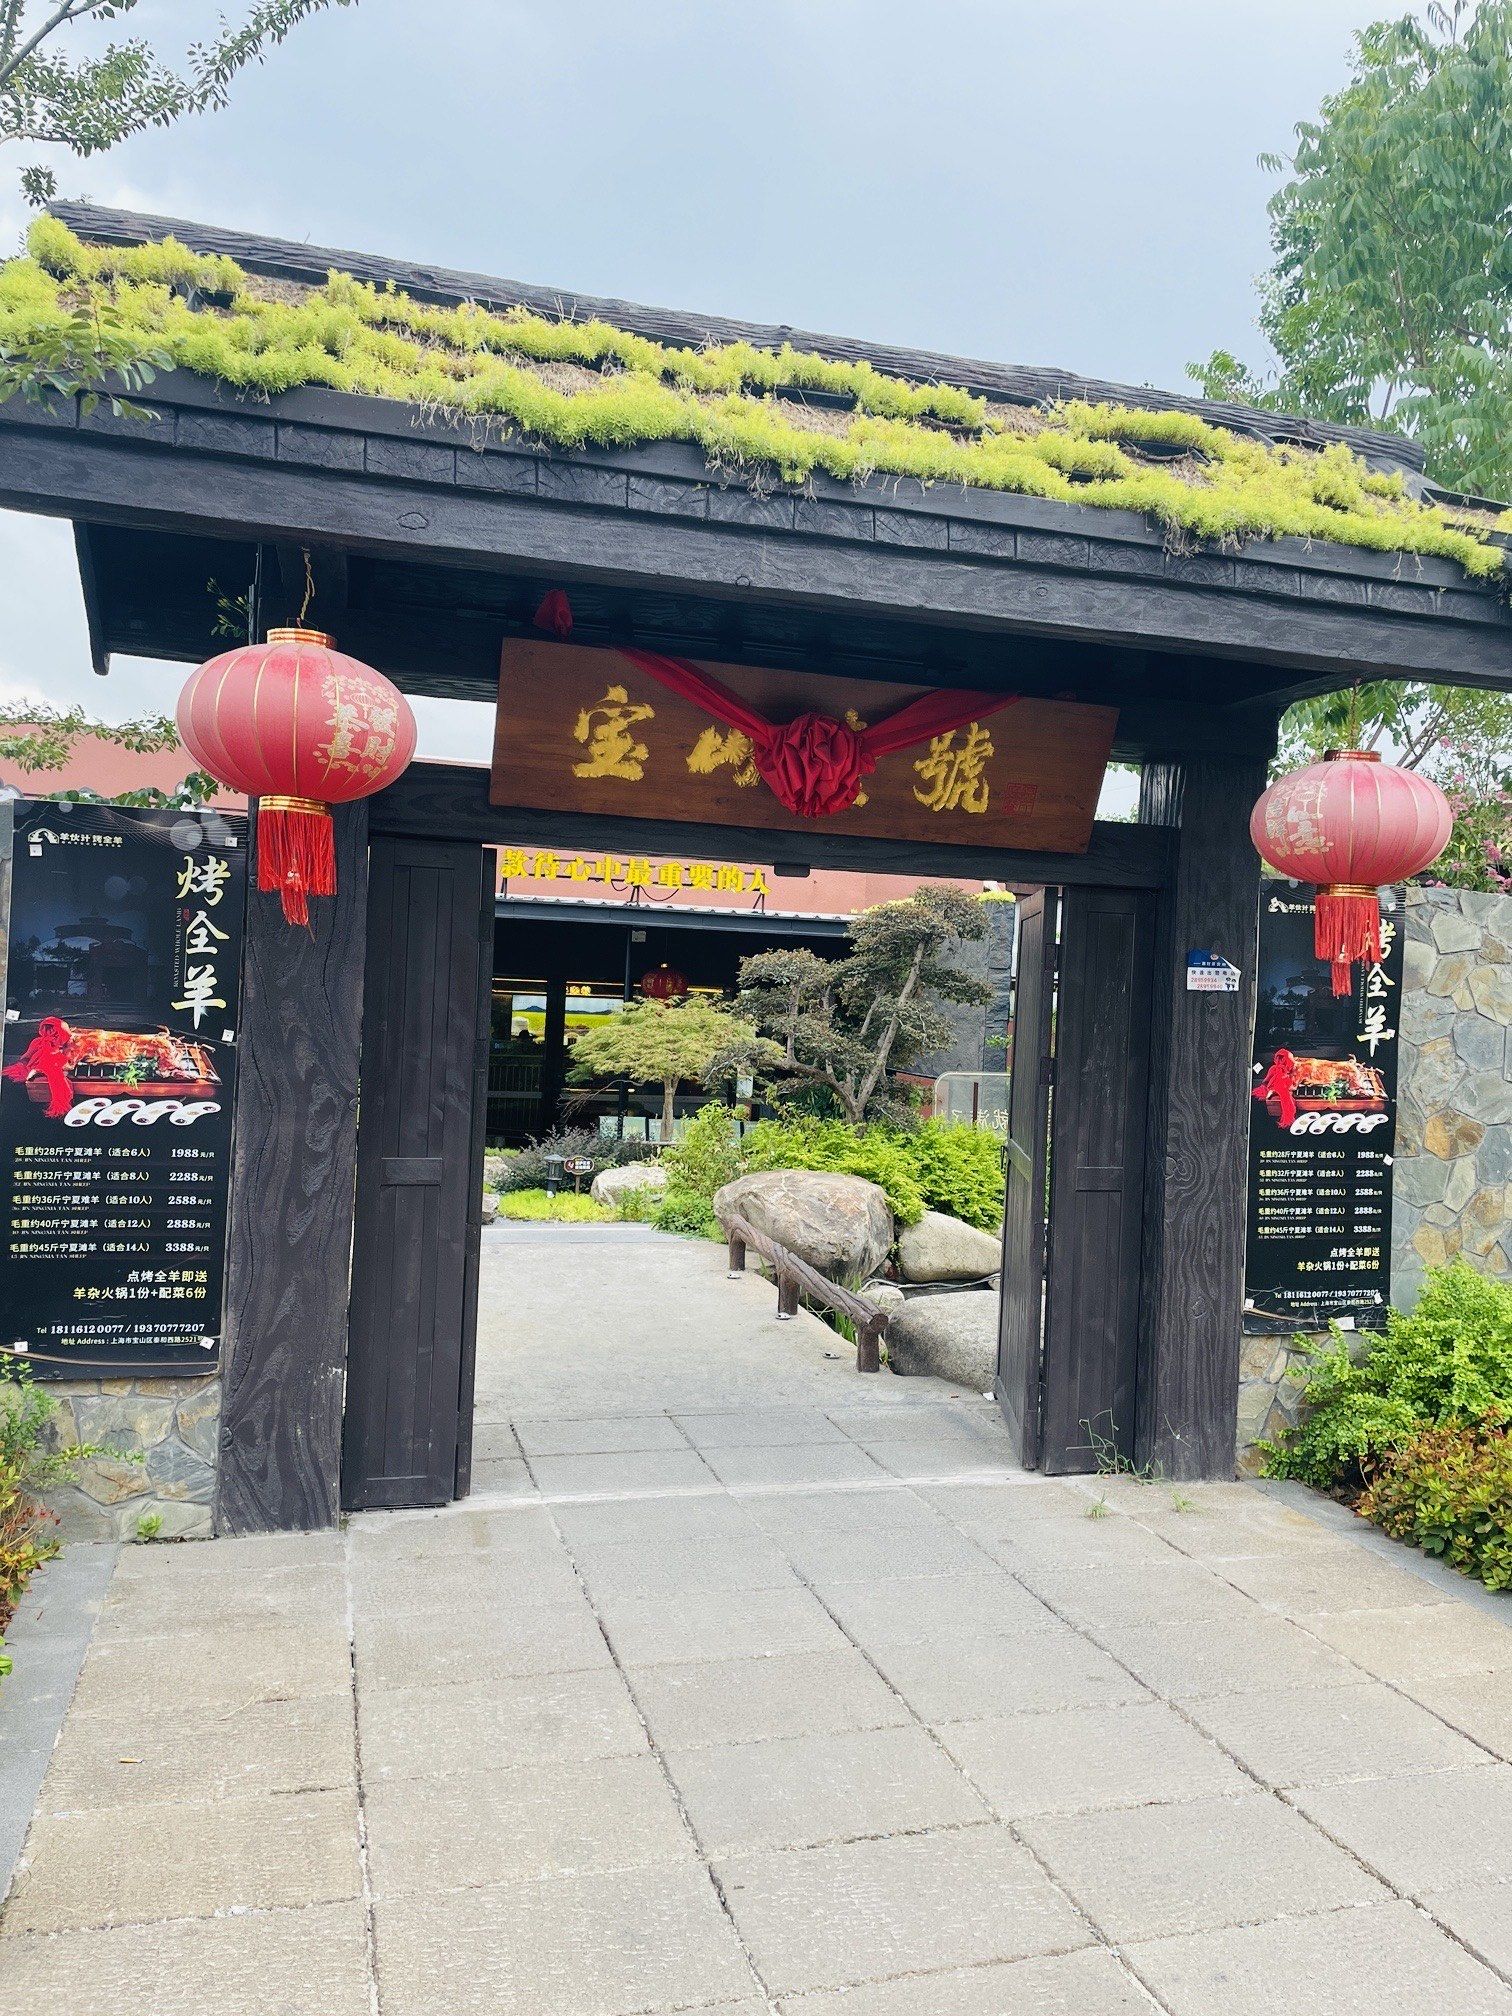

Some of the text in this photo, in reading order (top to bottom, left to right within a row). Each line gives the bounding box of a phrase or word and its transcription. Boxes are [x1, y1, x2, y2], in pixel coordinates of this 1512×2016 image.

[501, 849, 771, 894] 款待心中最重要的人
[171, 855, 230, 1029] 烤全羊
[127, 1270, 208, 1282] 点烤全羊即送
[73, 1287, 206, 1299] 羊杂火锅1份+配菜6份
[51, 1325, 124, 1334] 18116120077
